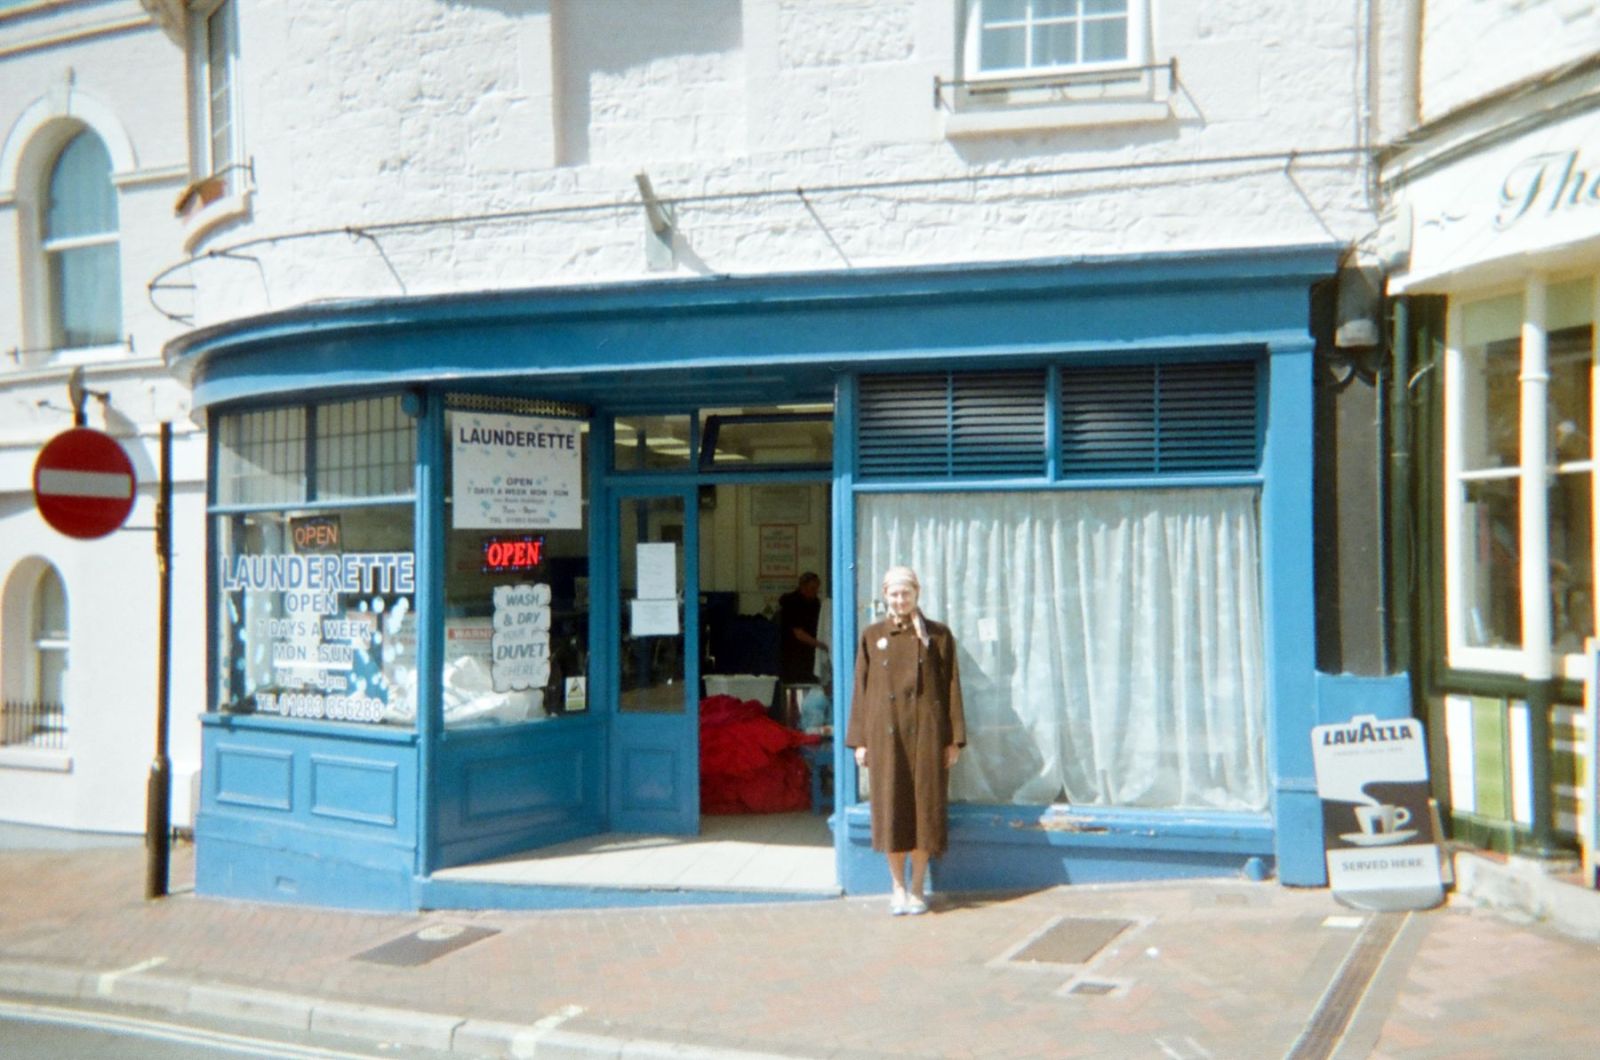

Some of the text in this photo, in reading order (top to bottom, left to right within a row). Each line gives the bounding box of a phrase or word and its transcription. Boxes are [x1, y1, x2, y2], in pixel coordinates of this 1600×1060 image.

[460, 427, 575, 449] LAUNDERETTE
[506, 477, 533, 486] OPEN
[295, 525, 339, 546] OPEN
[487, 542, 541, 567] OPEN
[222, 553, 415, 594] LAUNDERETTE
[286, 593, 339, 615] OPEN
[505, 593, 540, 607] WASH
[503, 611, 541, 626] & DRY
[270, 620, 306, 638] DAYS
[312, 622, 320, 637] A
[323, 620, 372, 640] WEEK
[273, 643, 307, 661] MON
[317, 643, 354, 663] SUN
[496, 642, 547, 660] DUVET
[318, 669, 347, 692] 9pm
[1323, 722, 1413, 746] LAVAZZA
[1341, 858, 1424, 873] SERVED HERE
